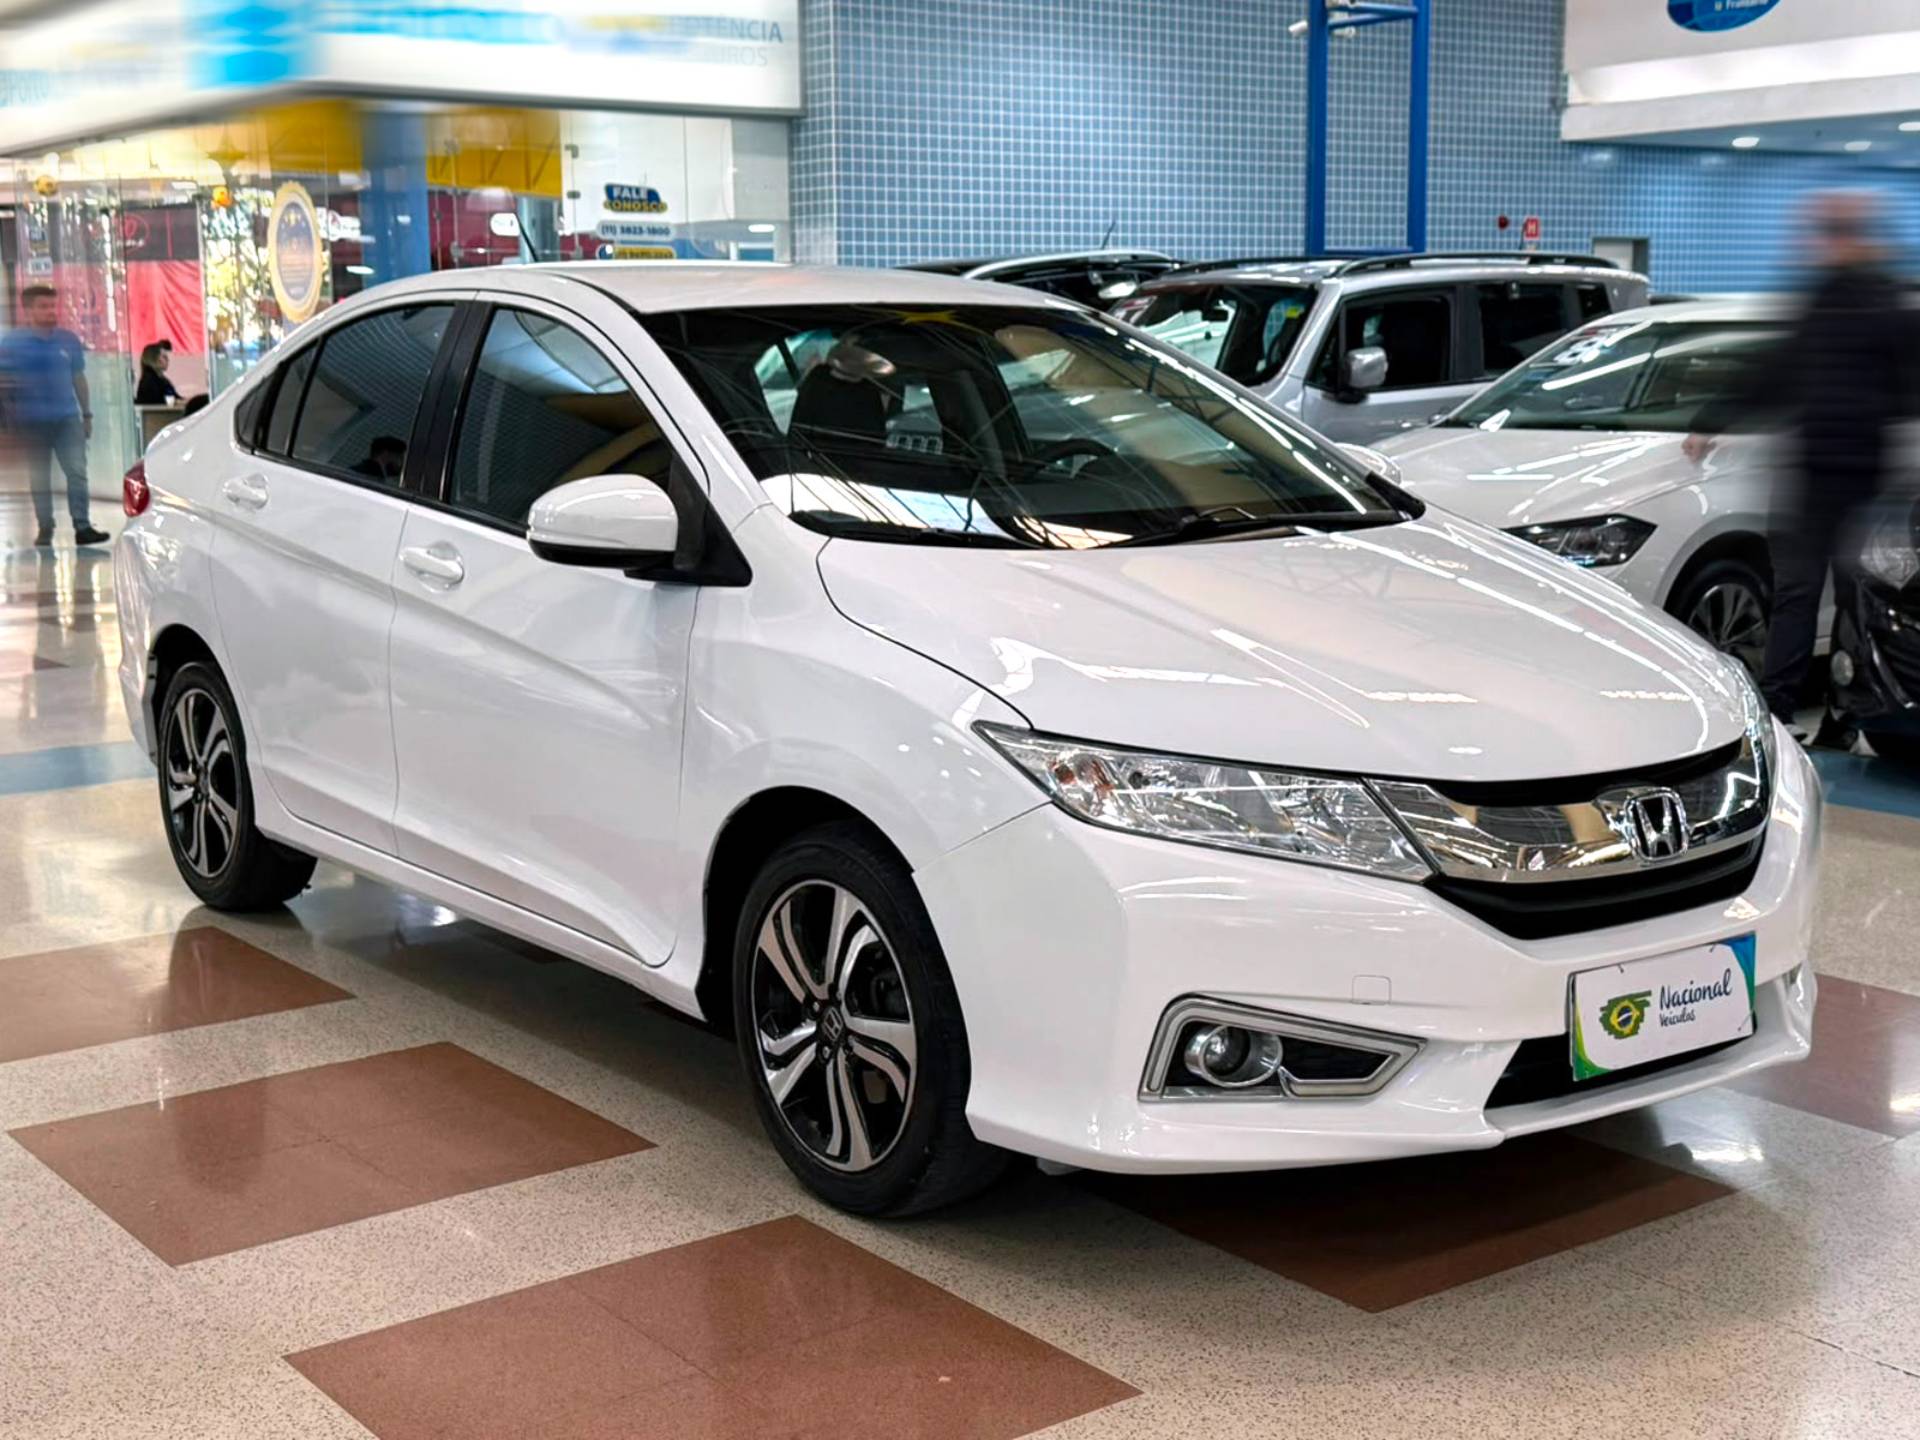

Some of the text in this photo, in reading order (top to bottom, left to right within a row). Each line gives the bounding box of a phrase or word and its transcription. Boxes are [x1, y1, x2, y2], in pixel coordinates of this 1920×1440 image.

[612, 186, 648, 200] FALE
[603, 200, 668, 212] CONOSCO
[1660, 968, 1732, 1010] Nacional
